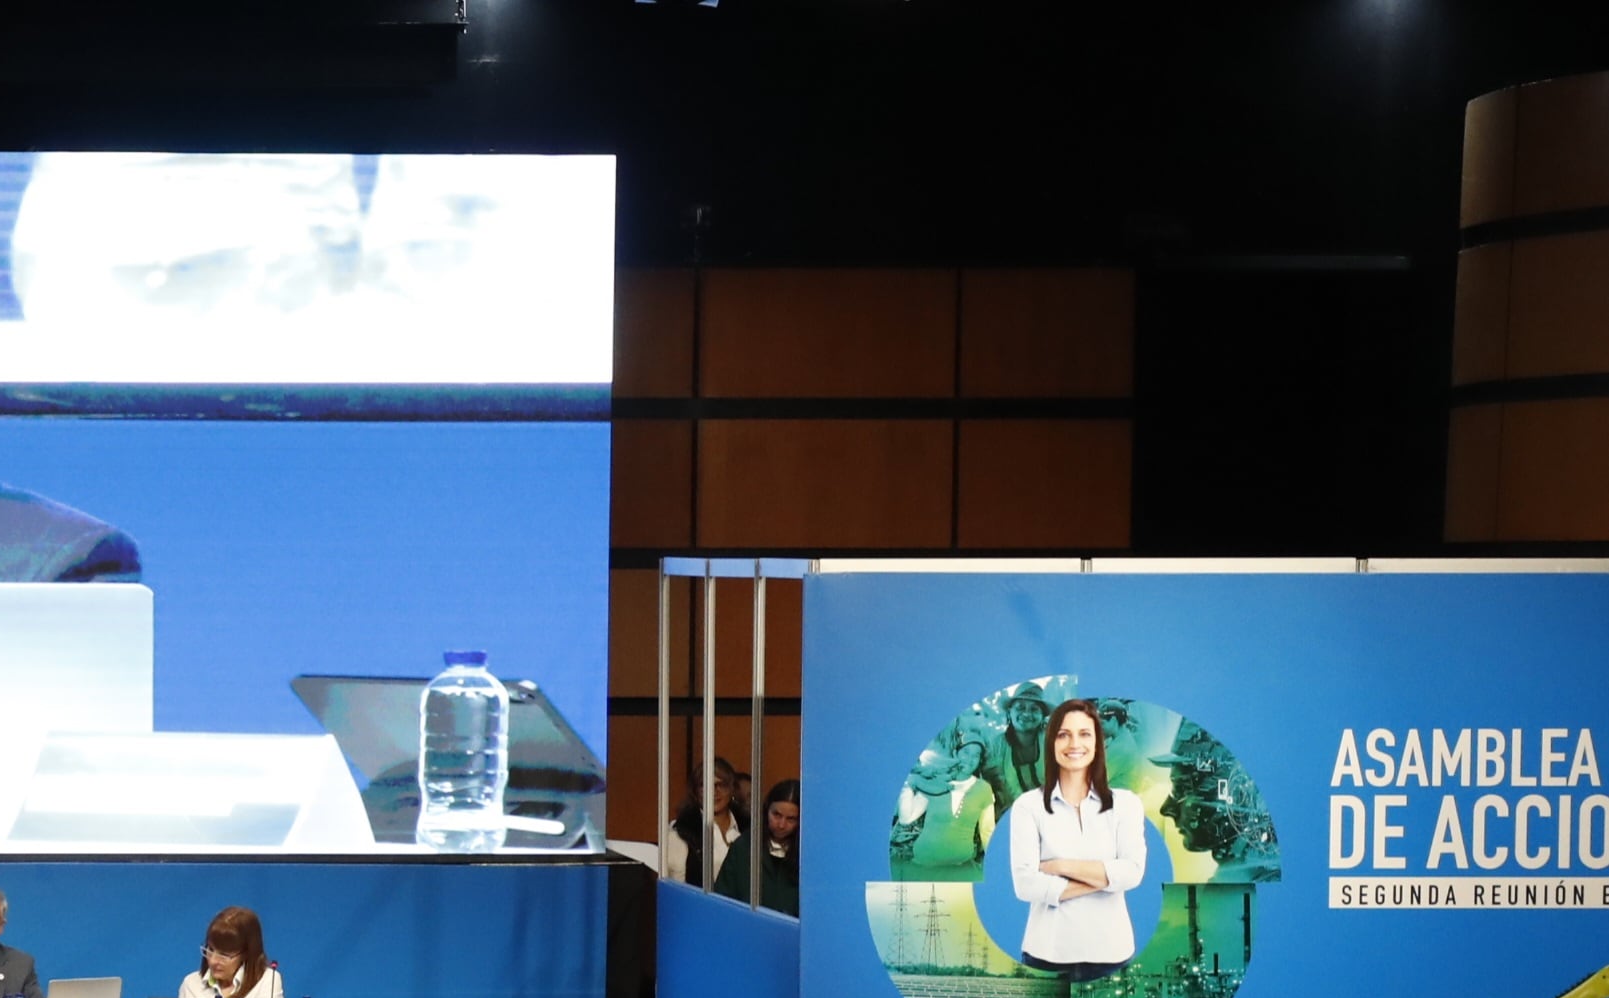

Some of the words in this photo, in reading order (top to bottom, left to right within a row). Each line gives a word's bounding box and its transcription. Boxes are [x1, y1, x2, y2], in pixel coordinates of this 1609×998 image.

[1330, 728, 1601, 787] ASAMBLEA
[1329, 795, 1407, 869] DE
[1426, 794, 1609, 869] ACCIO
[1342, 885, 1456, 905] SEGUNDA
[1474, 880, 1584, 905] REUNIÓN
